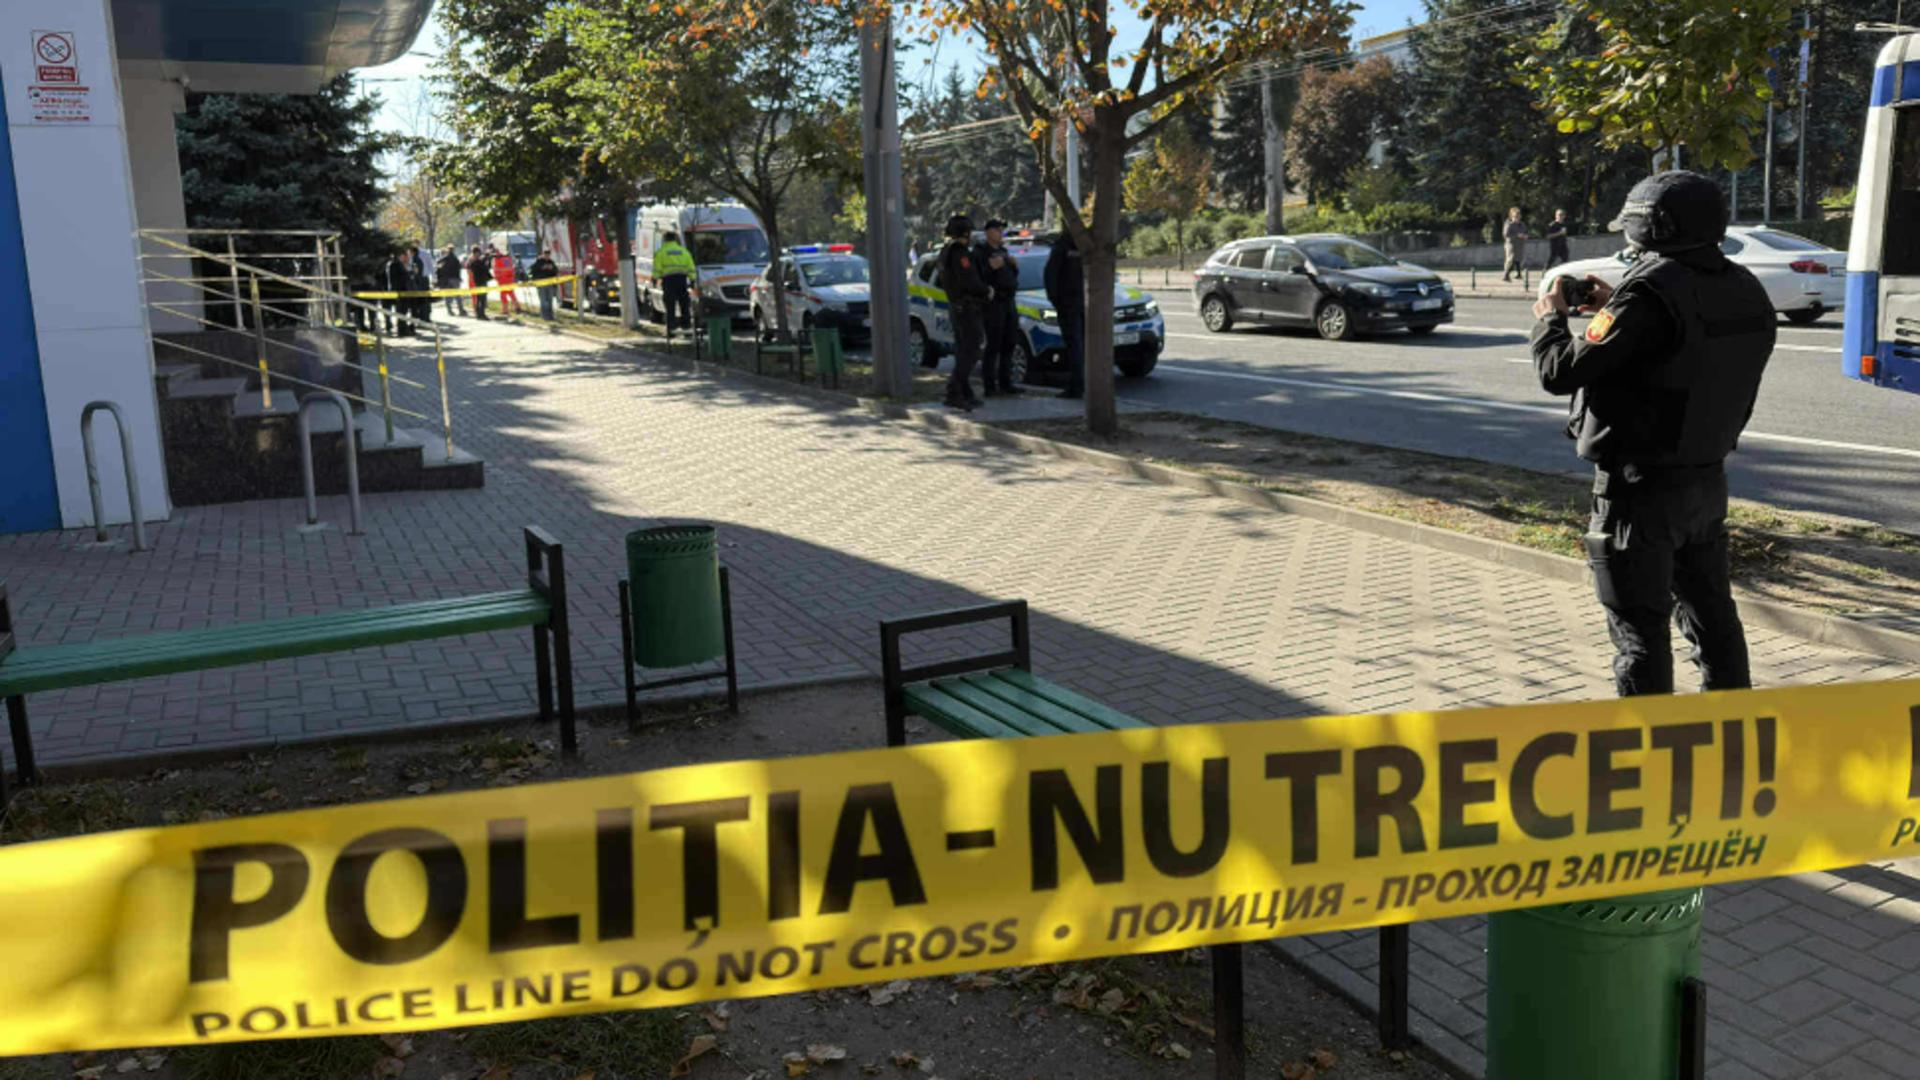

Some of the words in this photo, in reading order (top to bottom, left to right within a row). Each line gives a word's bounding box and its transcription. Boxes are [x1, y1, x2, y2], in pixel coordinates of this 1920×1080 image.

[1029, 757, 1230, 892] NU
[1107, 882, 1344, 941] ПОЛИЦИЯ
[1376, 858, 1551, 911] ПРОХОД
[1556, 829, 1768, 890] ЗАПРЕЩЁН
[191, 988, 434, 1037] POLICE
[455, 969, 591, 1014] LINE
[612, 957, 698, 997] DO
[716, 941, 834, 986] NOT
[847, 917, 1018, 970] CROSS
